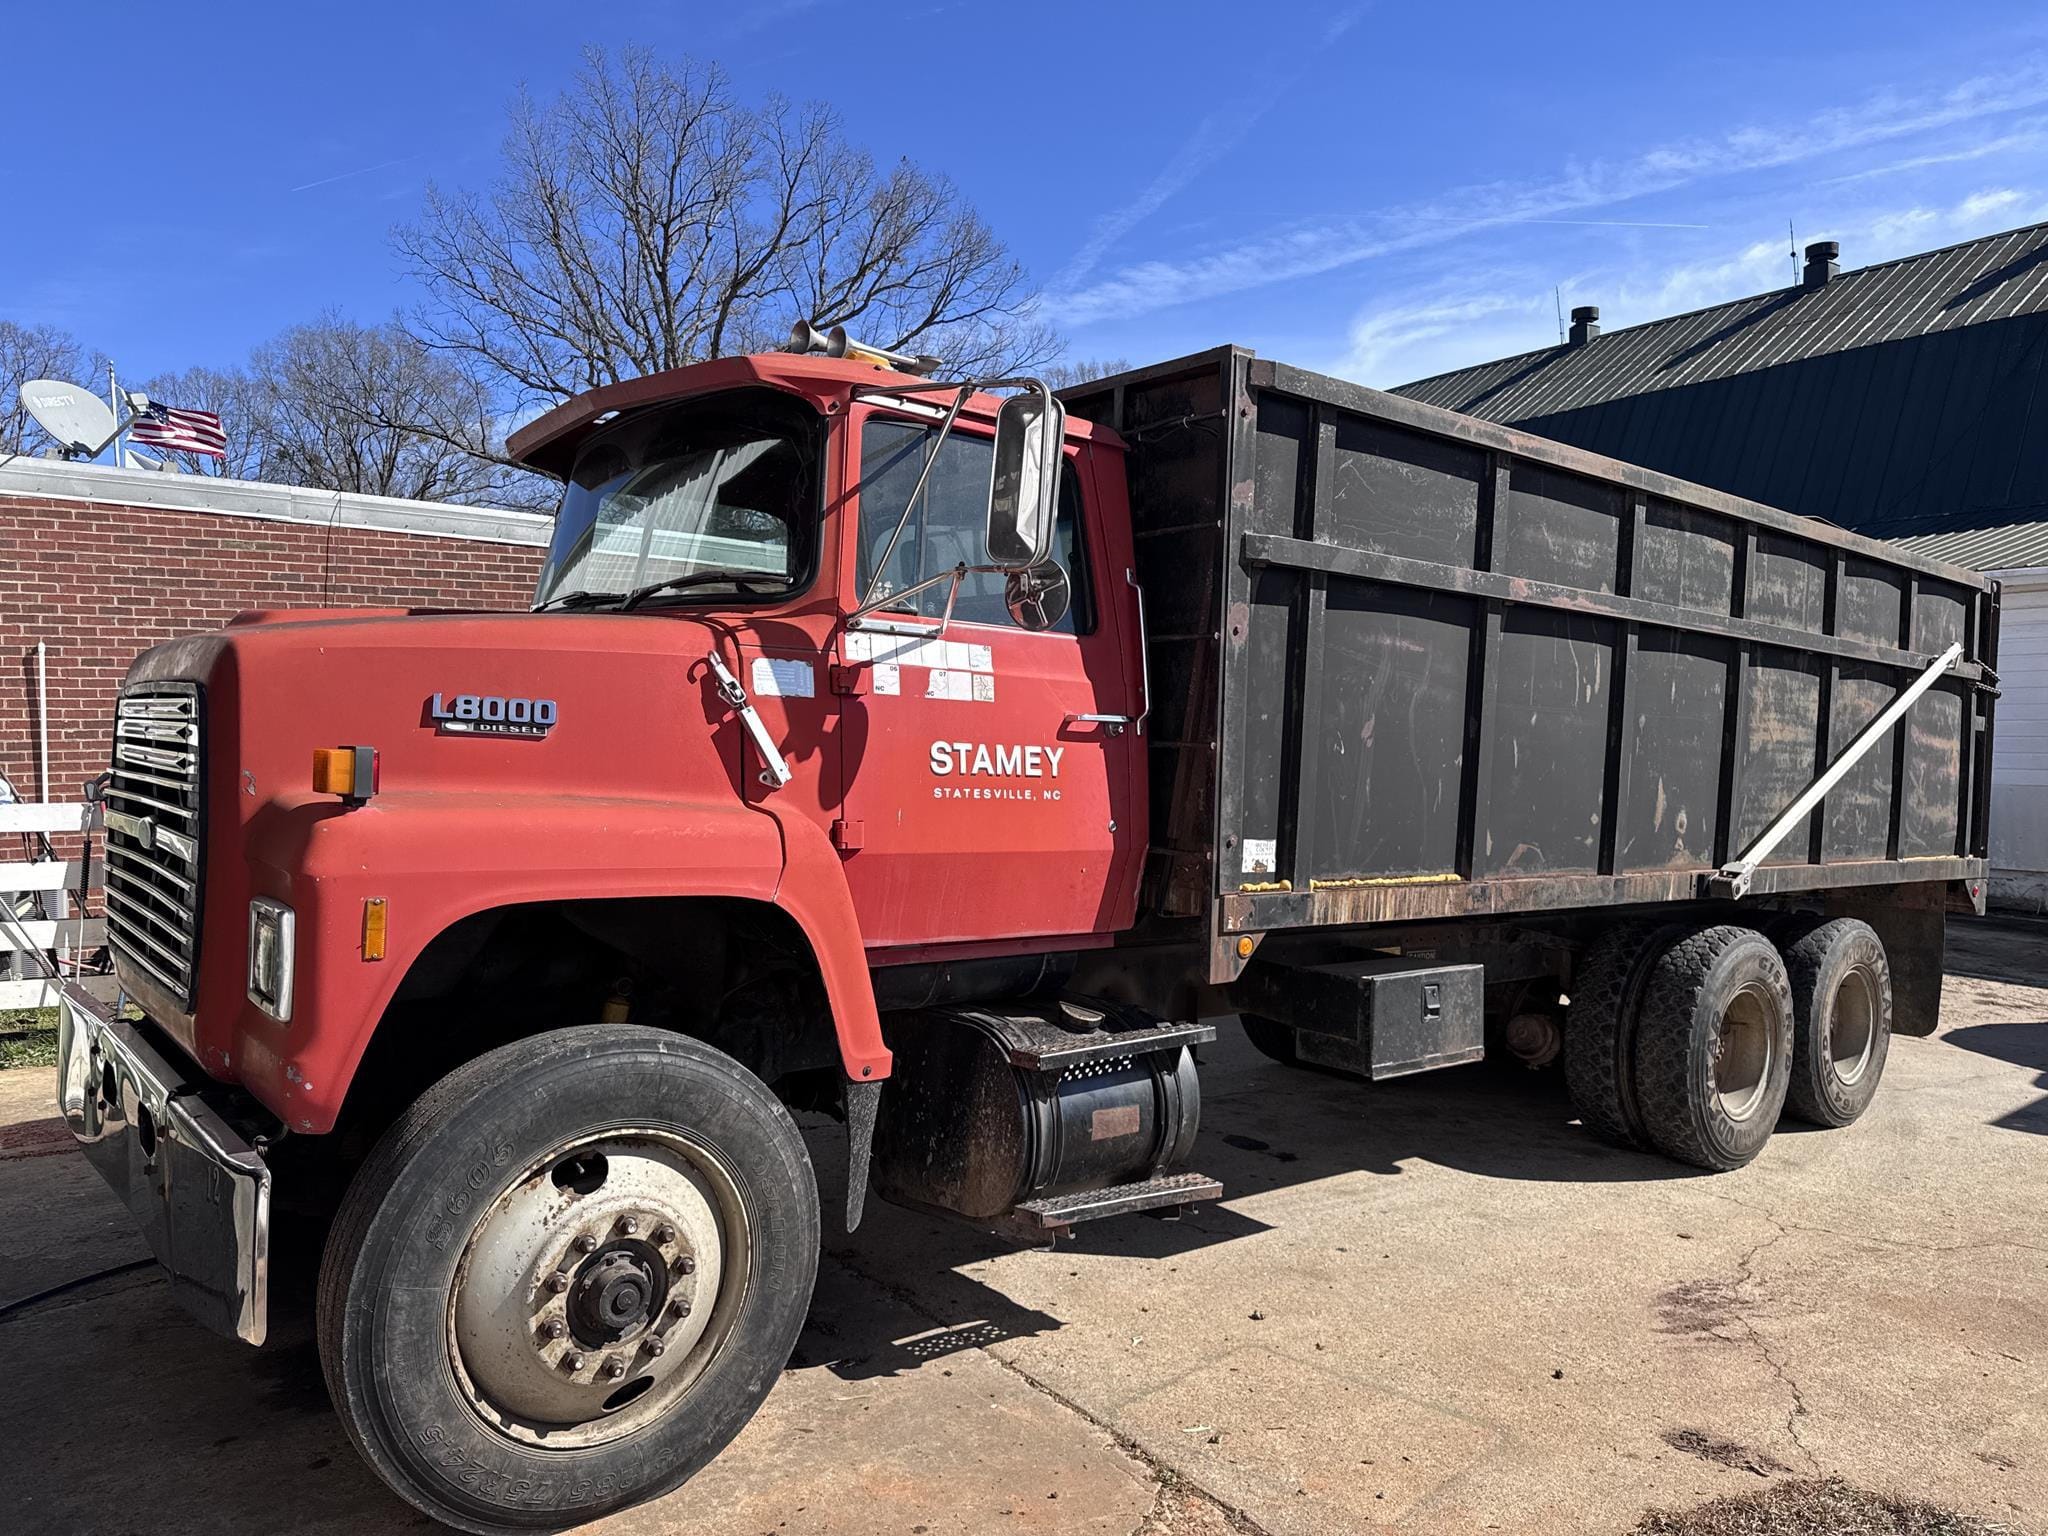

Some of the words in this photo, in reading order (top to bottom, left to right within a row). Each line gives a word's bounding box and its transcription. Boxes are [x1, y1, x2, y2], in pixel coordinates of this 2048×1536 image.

[40, 395, 76, 408] DIRECTV
[432, 693, 557, 724] L8000
[480, 724, 542, 734] DIESEL
[929, 740, 1064, 778] STAMEY
[934, 787, 1037, 801] STATESVILLE,
[1043, 789, 1061, 800] NC
[425, 1141, 515, 1251] S605
